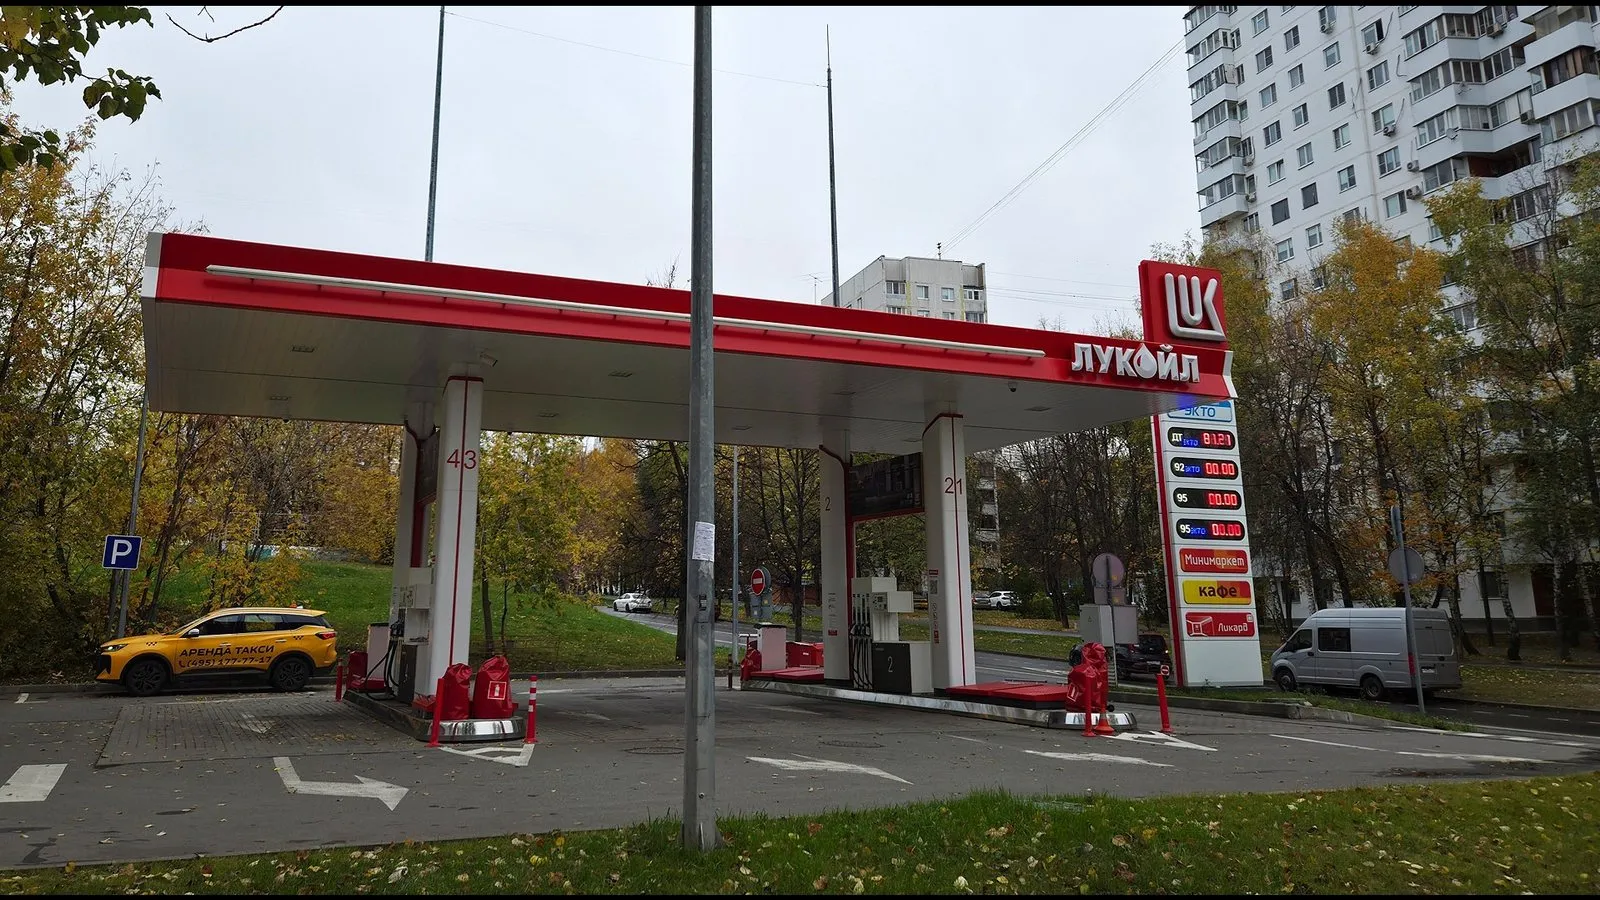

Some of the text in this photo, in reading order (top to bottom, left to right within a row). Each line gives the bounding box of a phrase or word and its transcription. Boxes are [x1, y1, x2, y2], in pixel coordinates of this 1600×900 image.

[1072, 343, 1200, 382] ЛУКОЙЛ
[1171, 432, 1183, 442] ДТ
[1174, 462, 1184, 472] 92
[1176, 493, 1237, 506] 95 00.00
[1180, 524, 1191, 533] 95
[1211, 523, 1241, 536] 00.00
[111, 540, 132, 564] P
[1184, 553, 1245, 569] Минимаркет
[1198, 585, 1237, 598] кафе
[1218, 622, 1248, 634] Ликард
[180, 645, 275, 657] АРЕНДА ТАКСИ
[887, 656, 893, 673] 2
